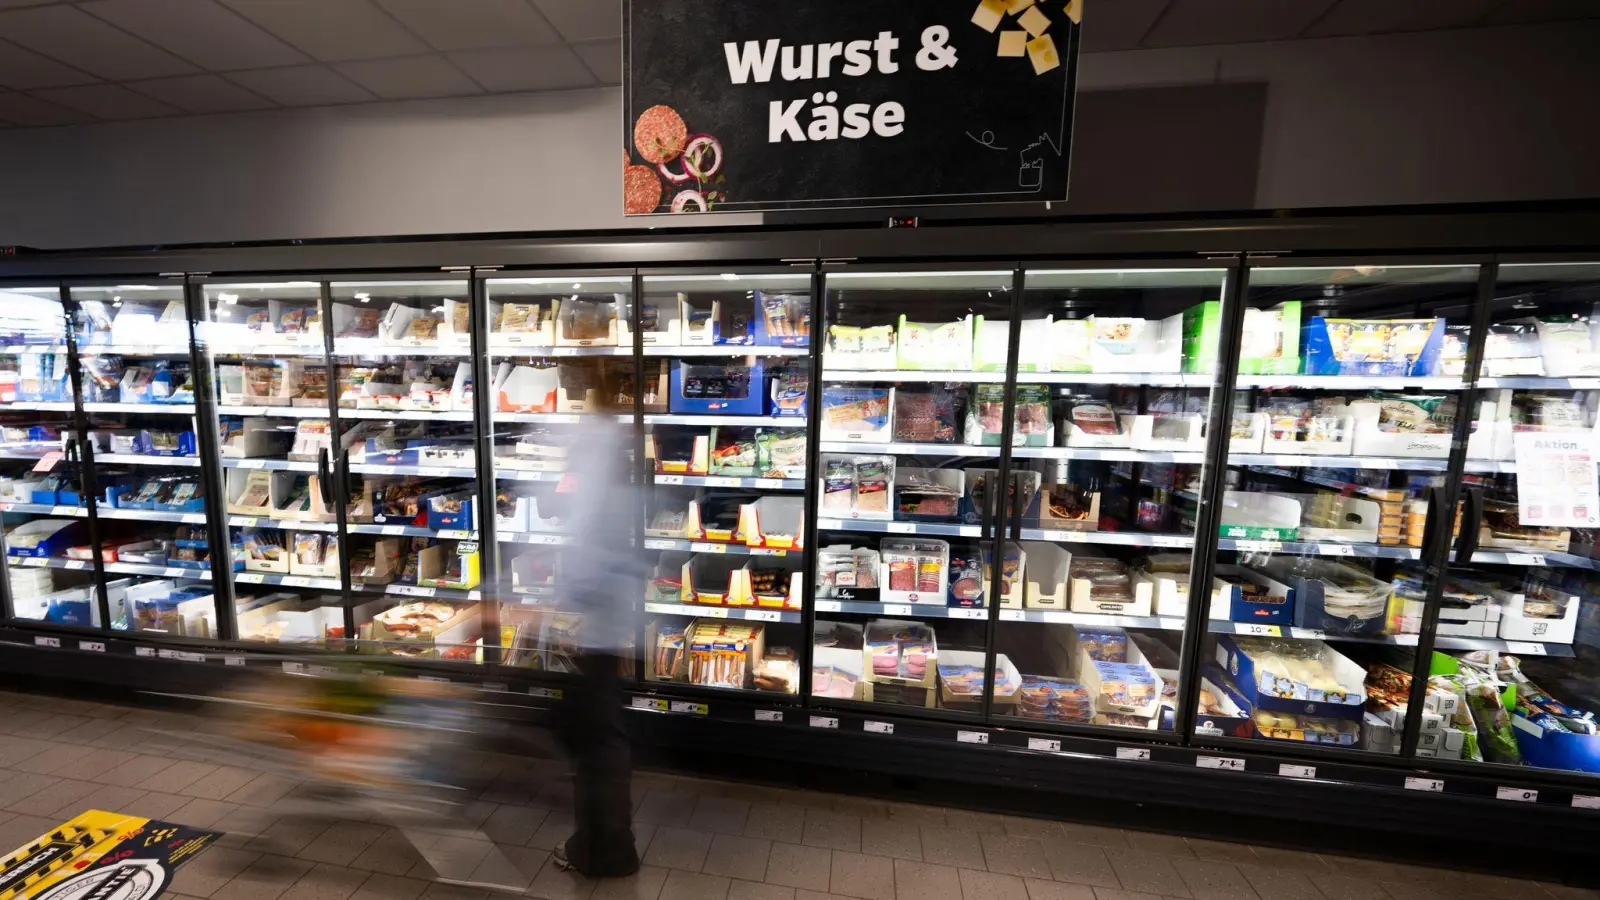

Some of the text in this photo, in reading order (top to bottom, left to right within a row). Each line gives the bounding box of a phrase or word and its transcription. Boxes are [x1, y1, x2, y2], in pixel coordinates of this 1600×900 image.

[724, 25, 959, 84] Wurst &
[768, 91, 905, 143] Käse
[1534, 440, 1578, 450] Aktion
